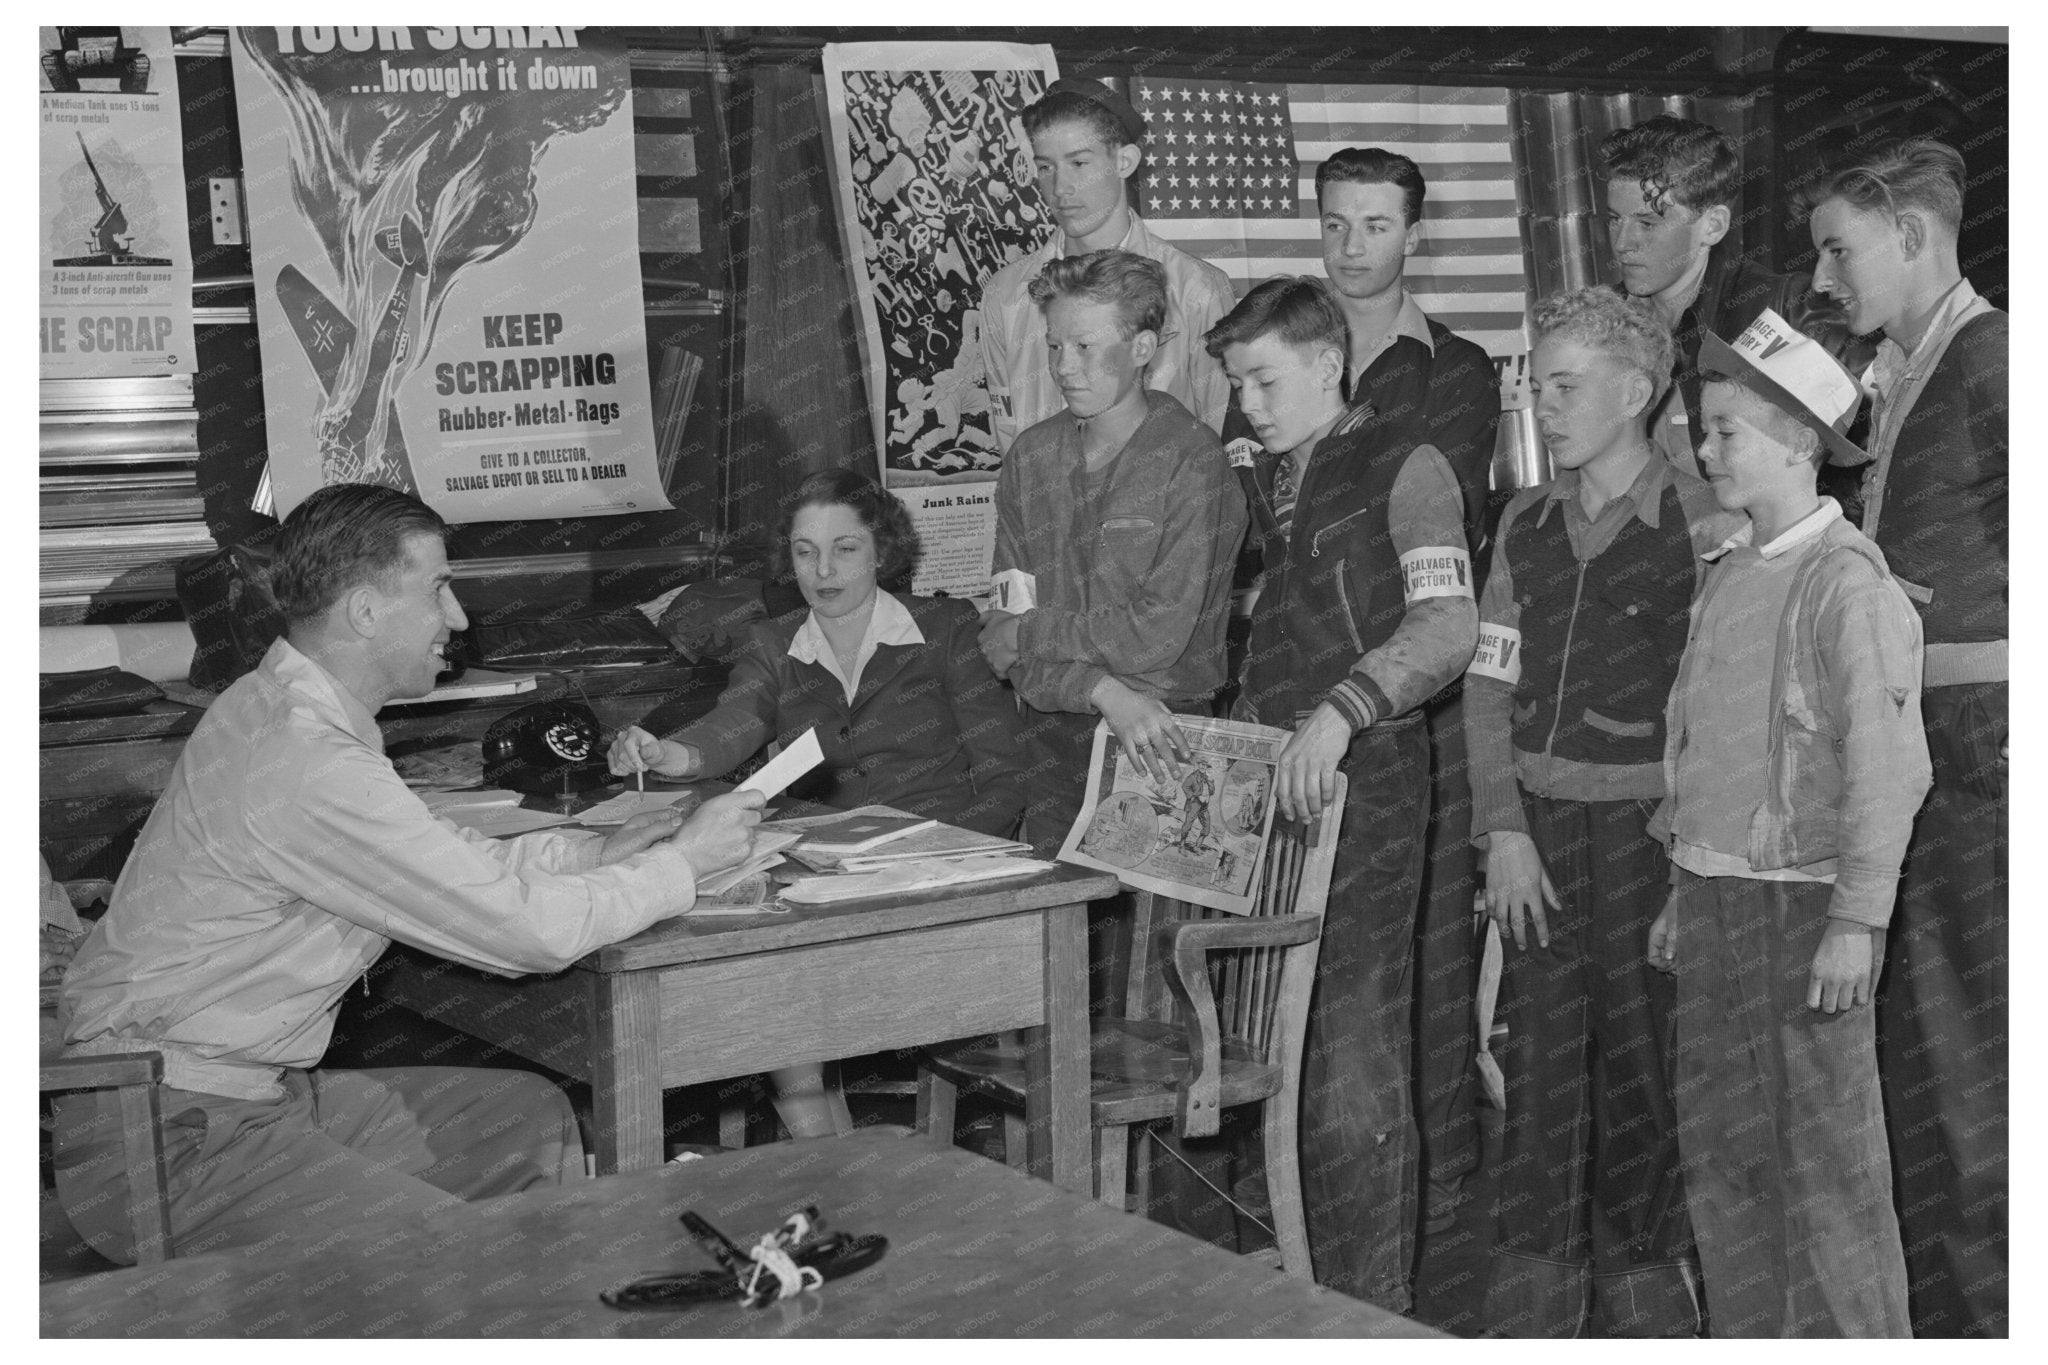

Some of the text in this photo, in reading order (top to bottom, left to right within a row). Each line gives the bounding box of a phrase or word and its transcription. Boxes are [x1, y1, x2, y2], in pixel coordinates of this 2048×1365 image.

[497, 58, 517, 91] it
[527, 57, 598, 91] down
[43, 99, 160, 112] A Medium Tank uses 15 tons
[44, 114, 110, 125] of scrap metals
[53, 271, 172, 282] A 3-inch Anti-aircraft Gun uses
[53, 284, 148, 296] 3 tons of scrap metals
[78, 316, 173, 353] SCRAP
[482, 312, 563, 349] KEEP
[1758, 334, 1790, 360] V
[435, 353, 617, 396] SCRAPPING
[1000, 395, 1013, 417] V
[480, 447, 591, 470] GIVE TO A COLLECTOR,
[445, 463, 627, 492] SALVAGE DEPOT OR SELL TO A DEALER
[922, 495, 990, 508] Junk Rains
[1410, 557, 1452, 573] SALVAGE
[1453, 558, 1466, 586] V
[1411, 574, 1453, 589] VICTORY
[1000, 581, 1009, 608] V
[1499, 638, 1516, 669] V
